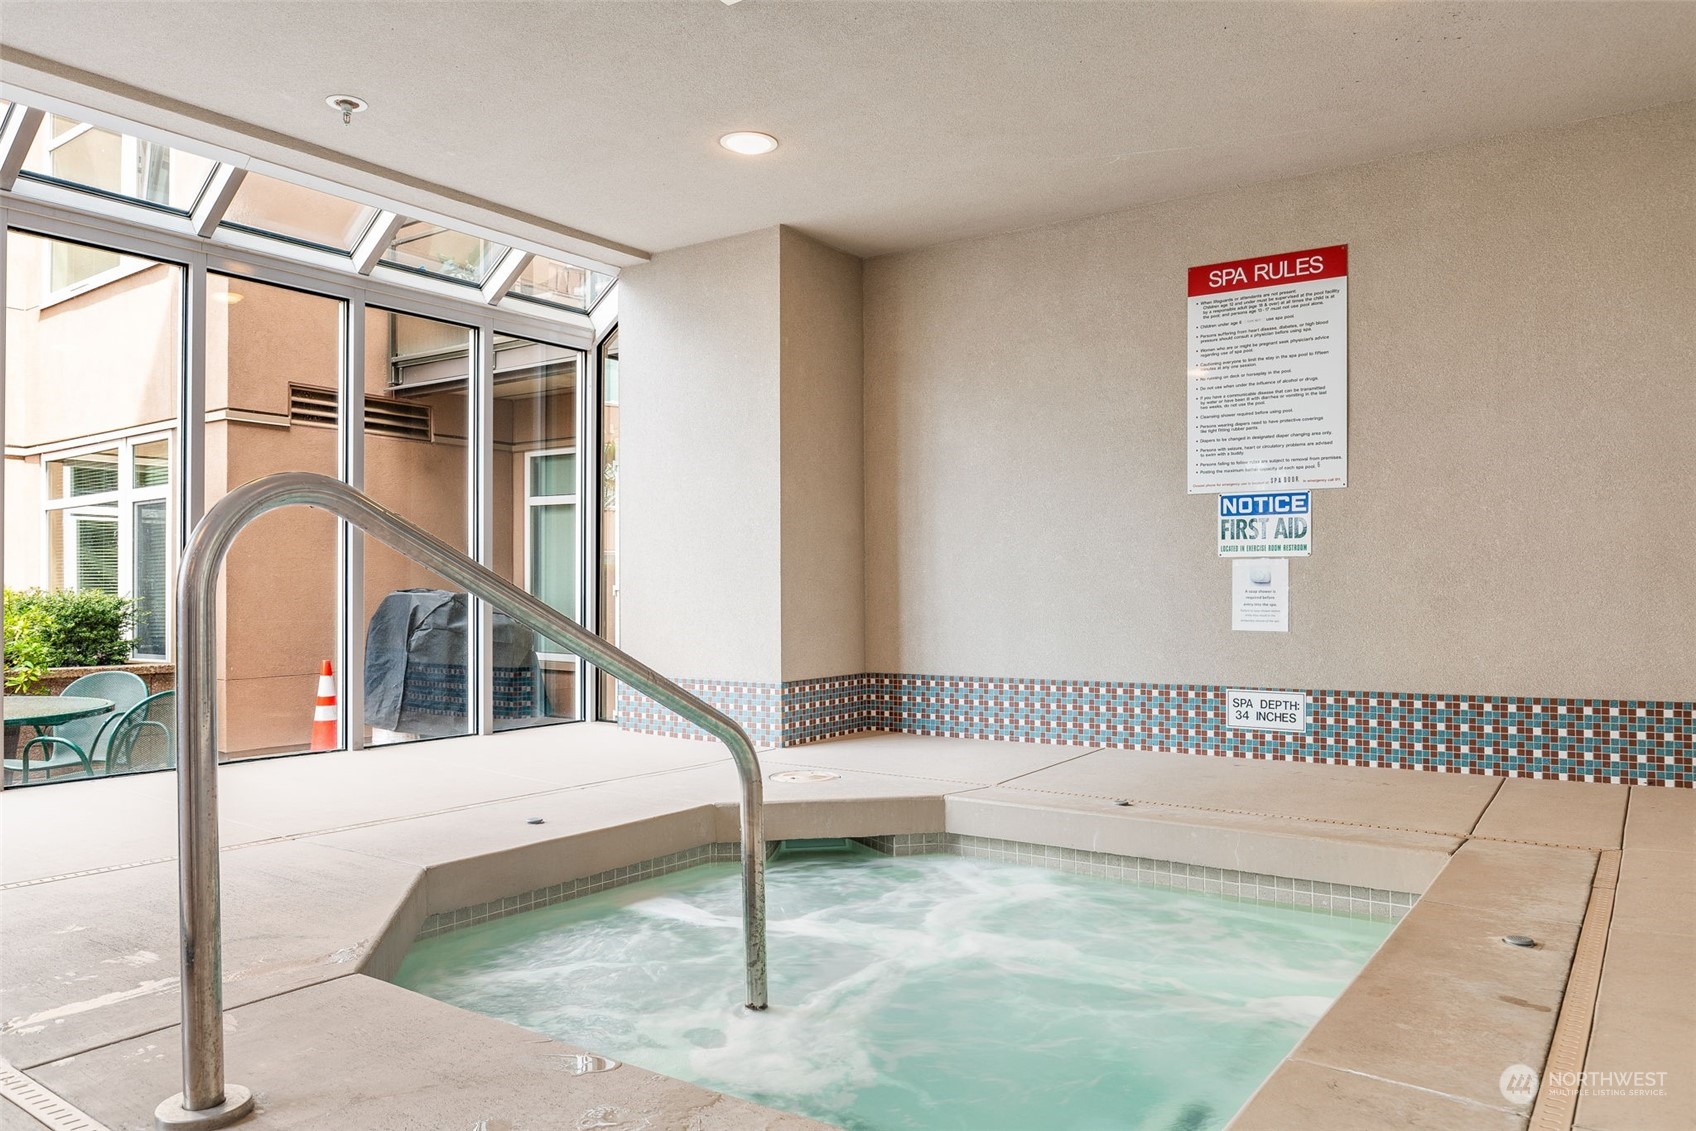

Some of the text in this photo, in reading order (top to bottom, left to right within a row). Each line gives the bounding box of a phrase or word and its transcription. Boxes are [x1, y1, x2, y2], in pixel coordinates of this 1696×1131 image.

[1209, 256, 1324, 288] SPA RULES
[1222, 495, 1307, 514] NOTICE
[1221, 517, 1308, 540] FIRST AID
[1233, 698, 1300, 710] SPA DEPTH:
[1235, 710, 1296, 723] 34 INCHES
